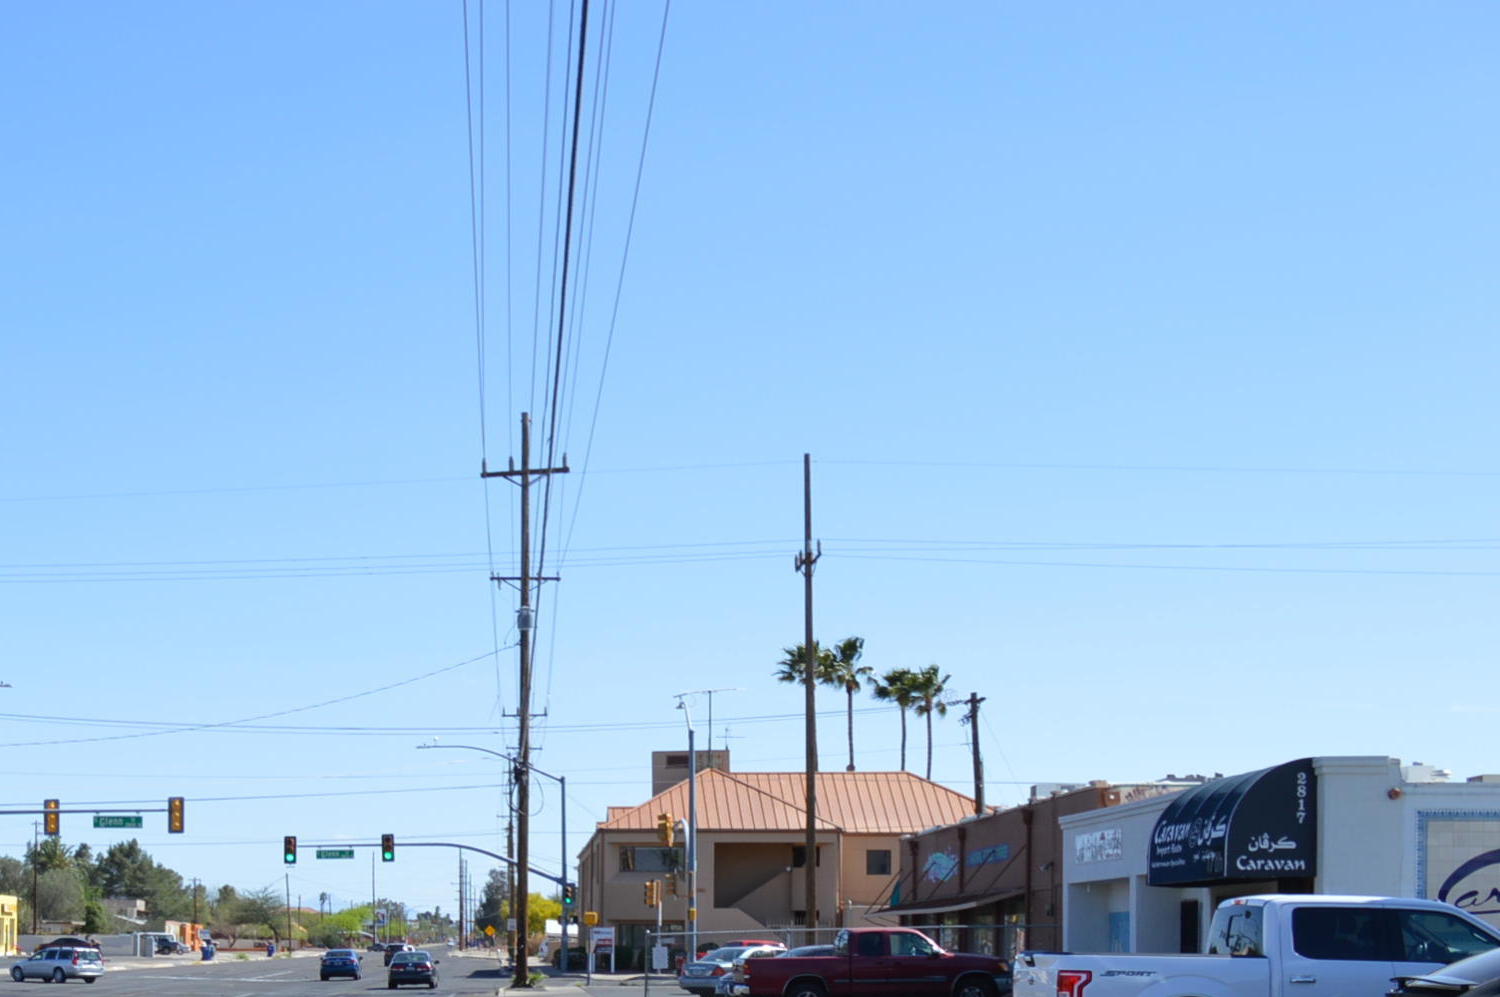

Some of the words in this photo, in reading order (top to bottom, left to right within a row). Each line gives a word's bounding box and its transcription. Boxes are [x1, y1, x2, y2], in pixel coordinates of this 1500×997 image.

[1296, 772, 1307, 824] 2817
[1155, 820, 1191, 844] Caravan
[1236, 855, 1306, 870] Caravan
